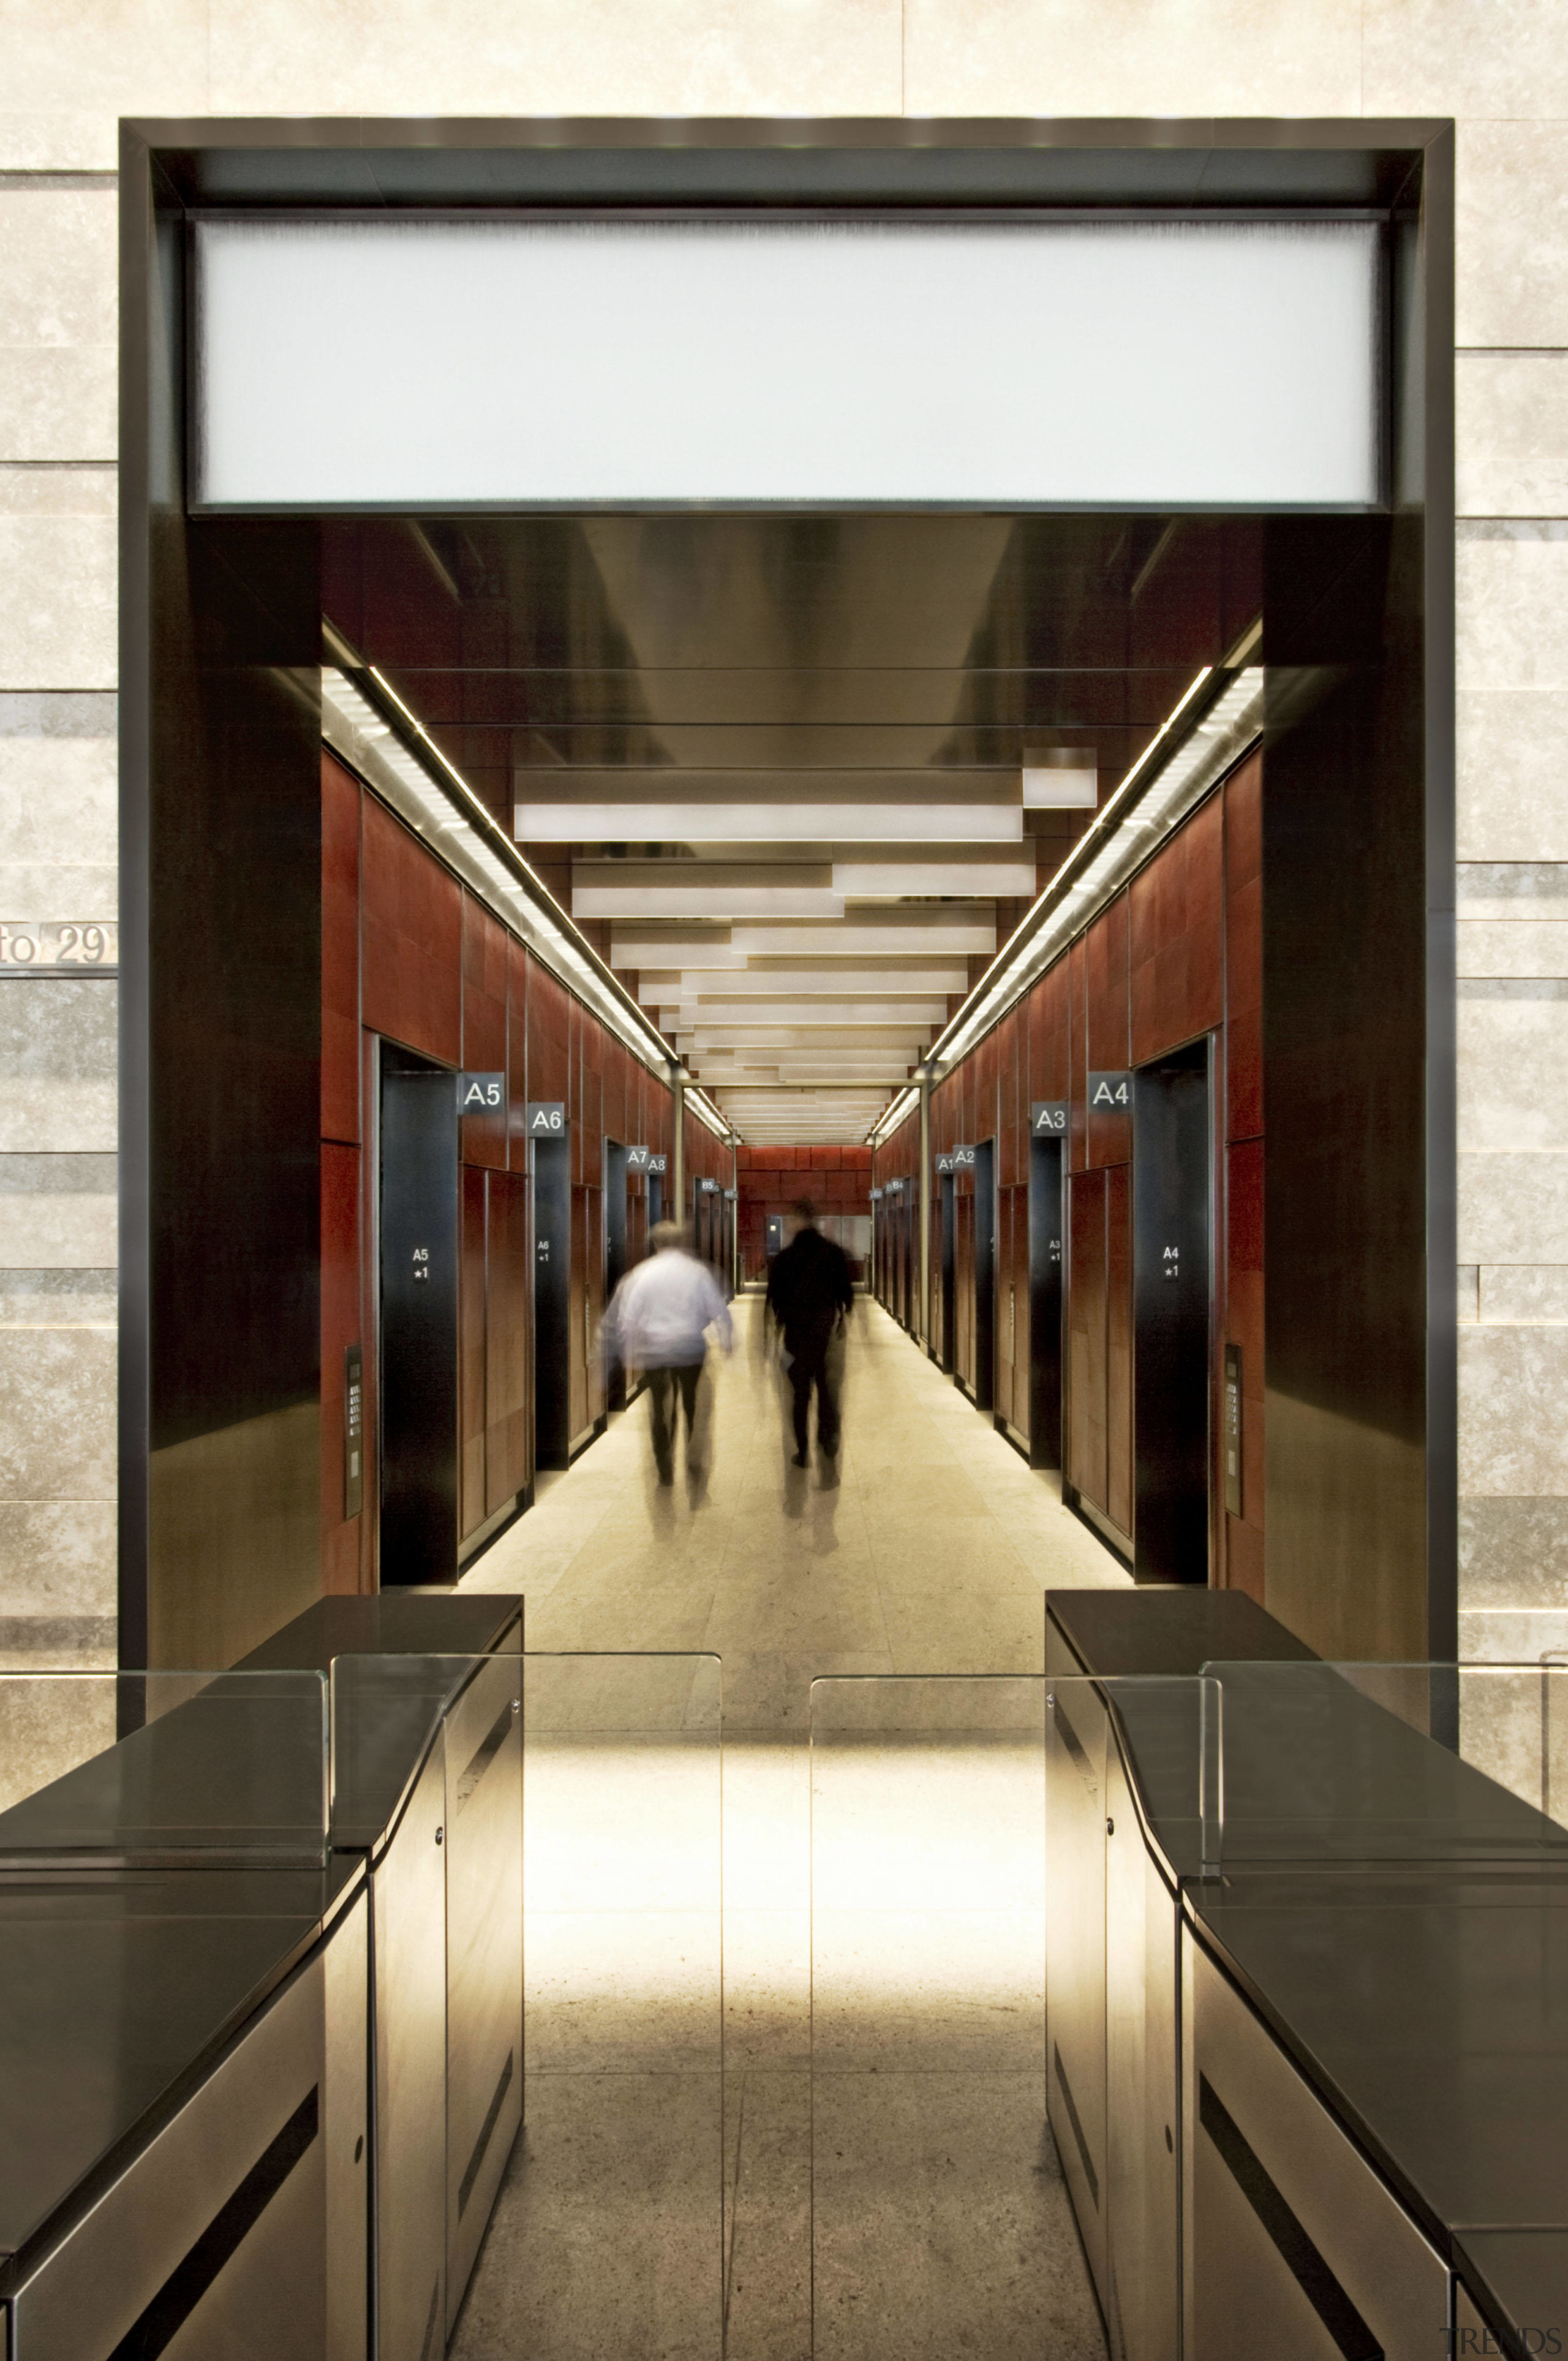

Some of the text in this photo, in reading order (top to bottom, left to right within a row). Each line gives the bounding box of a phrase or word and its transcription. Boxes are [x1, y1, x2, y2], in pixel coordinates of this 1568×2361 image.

[56, 925, 105, 964] 29
[464, 1082, 500, 1105] A5
[1093, 1082, 1129, 1104] A4
[532, 1111, 561, 1129] A6
[1036, 1110, 1065, 1128] A3
[628, 1150, 646, 1163] A7
[955, 1150, 974, 1163] A2
[647, 1159, 665, 1171] A8
[938, 1158, 953, 1169] A1
[538, 1241, 549, 1250] A6
[1049, 1240, 1061, 1248] A3
[413, 1248, 429, 1261] A5
[1163, 1247, 1179, 1259] A4
